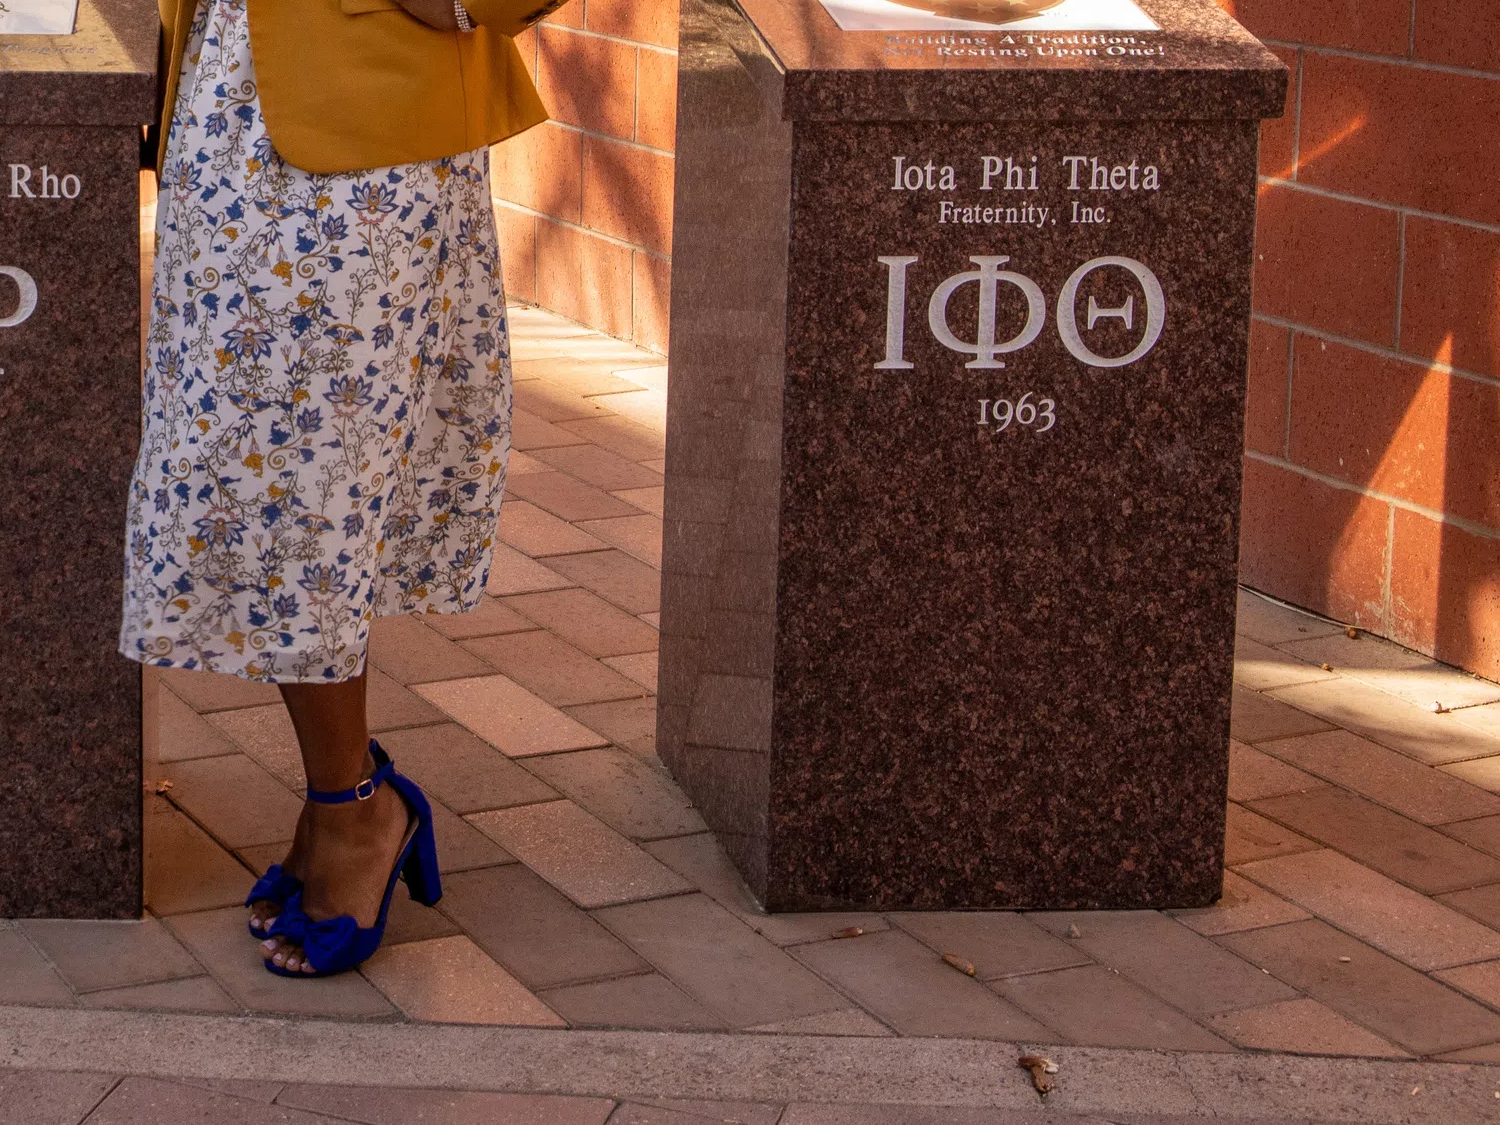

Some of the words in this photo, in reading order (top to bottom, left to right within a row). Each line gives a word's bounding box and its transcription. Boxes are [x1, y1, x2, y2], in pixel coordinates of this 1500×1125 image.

[937, 45, 1029, 58] Resting
[1036, 45, 1095, 58] Upon
[1105, 44, 1166, 57] One!
[999, 34, 1016, 45] A
[1025, 33, 1147, 46] Tradition,
[8, 163, 82, 200] Rho
[891, 155, 957, 191] Iota
[979, 155, 1040, 191] Phi
[1062, 155, 1161, 191] Theta
[938, 200, 1057, 229] Fraternity,
[1070, 200, 1112, 224] Inc.
[873, 254, 1166, 370] ΙΦΘ
[976, 391, 1057, 433] 1963
